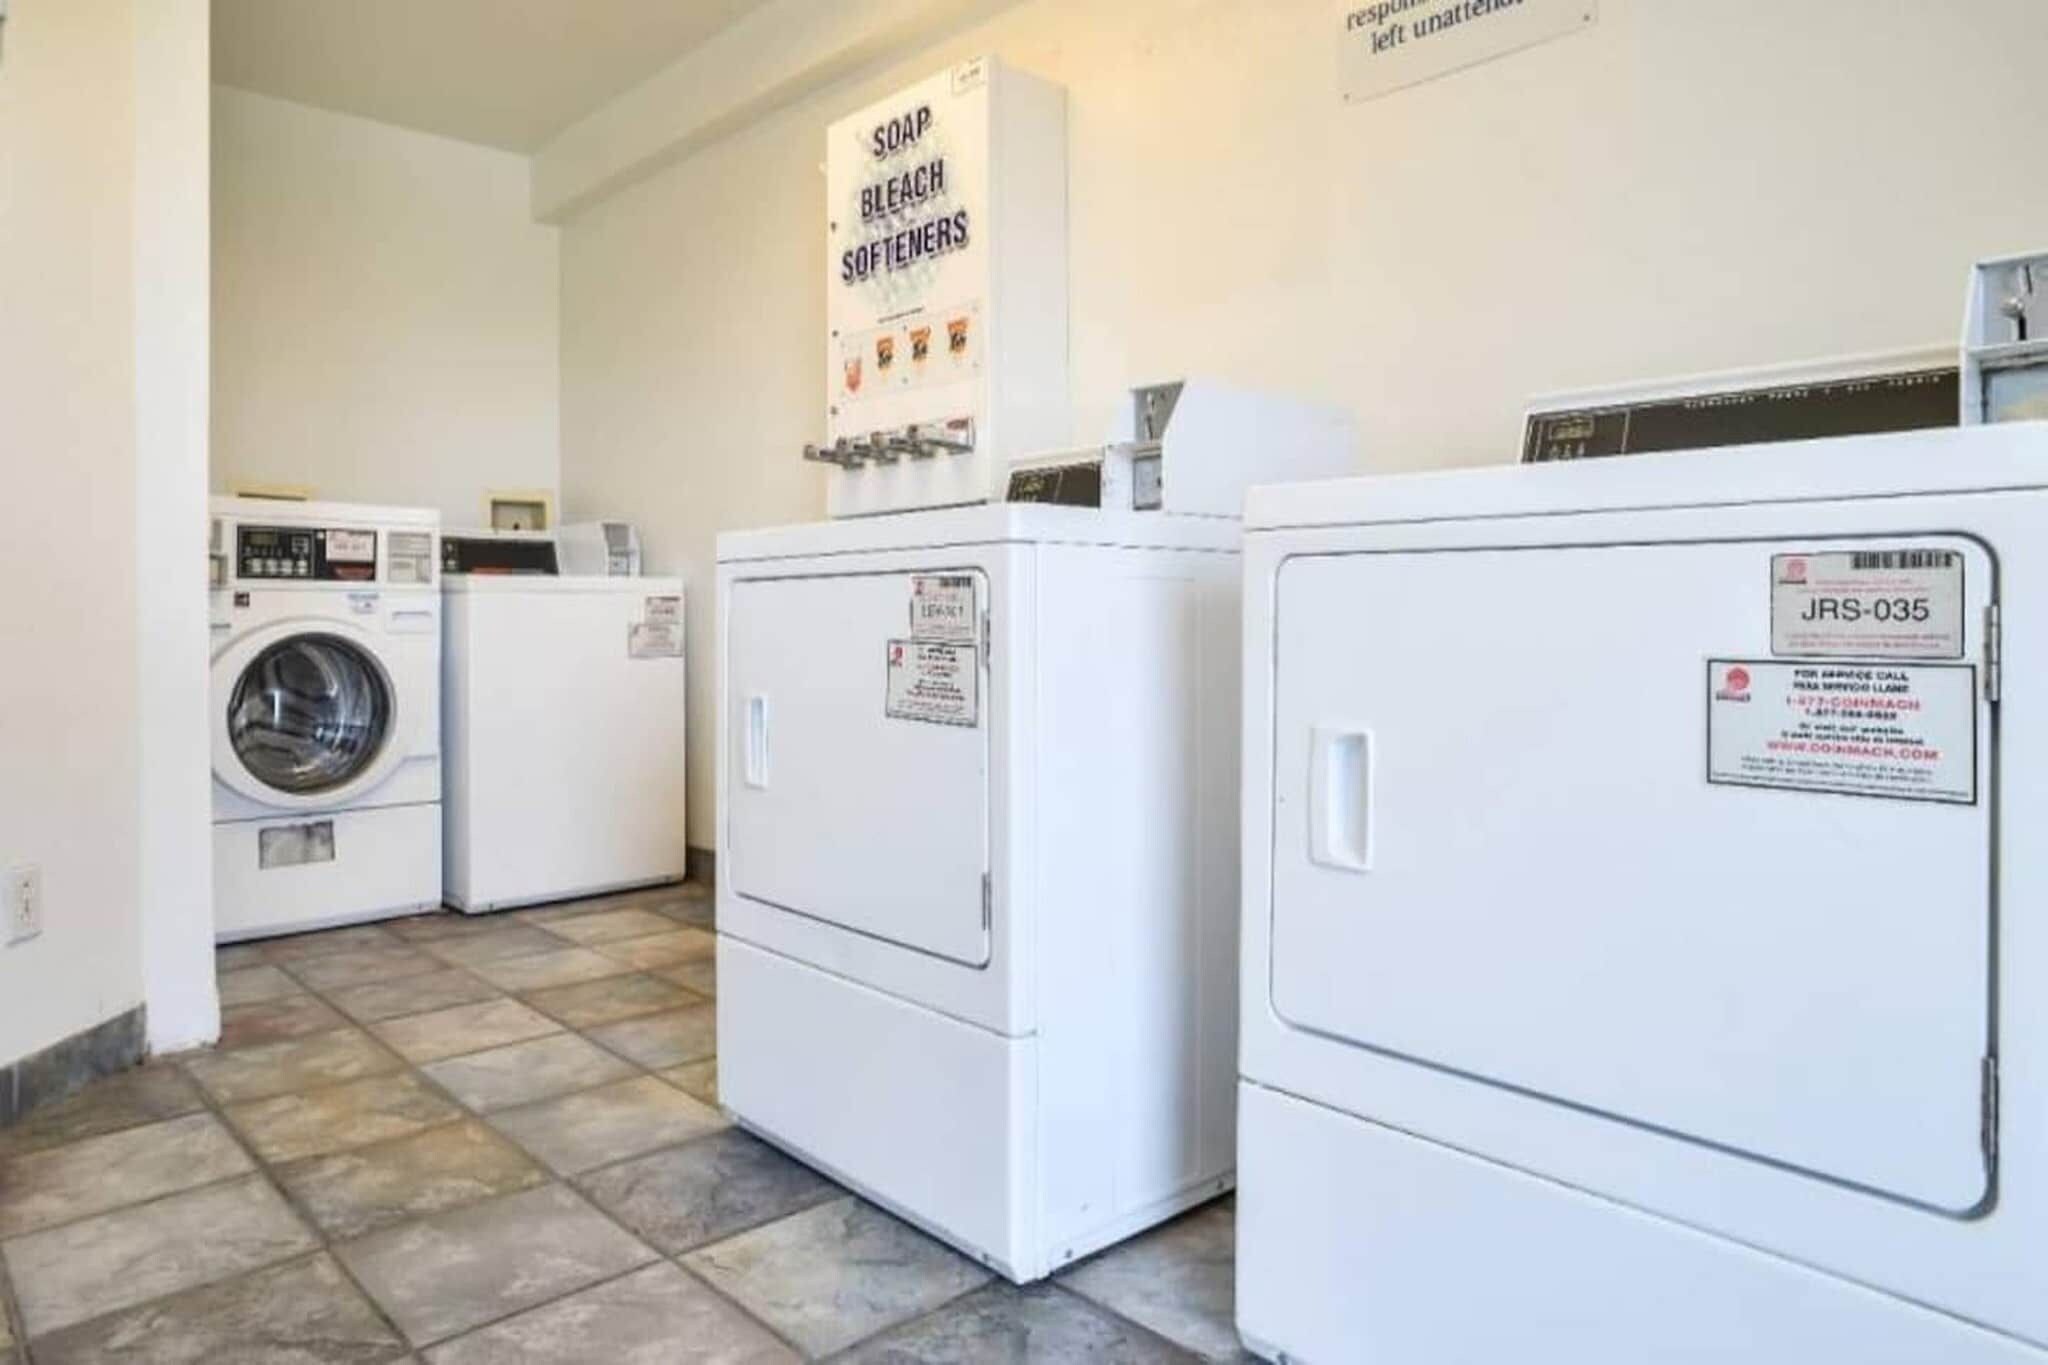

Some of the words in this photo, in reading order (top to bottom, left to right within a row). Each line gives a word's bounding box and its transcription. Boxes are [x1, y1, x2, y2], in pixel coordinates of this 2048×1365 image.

[1371, 22, 1406, 54] left
[872, 105, 932, 161] SOAP
[861, 158, 945, 221] BLEACH
[841, 209, 968, 285] SOFTENERS
[1801, 597, 1930, 622] JRS-035
[1794, 669, 1818, 679] FOR
[1822, 669, 1873, 681] SERVICE
[1876, 671, 1910, 682] CALL
